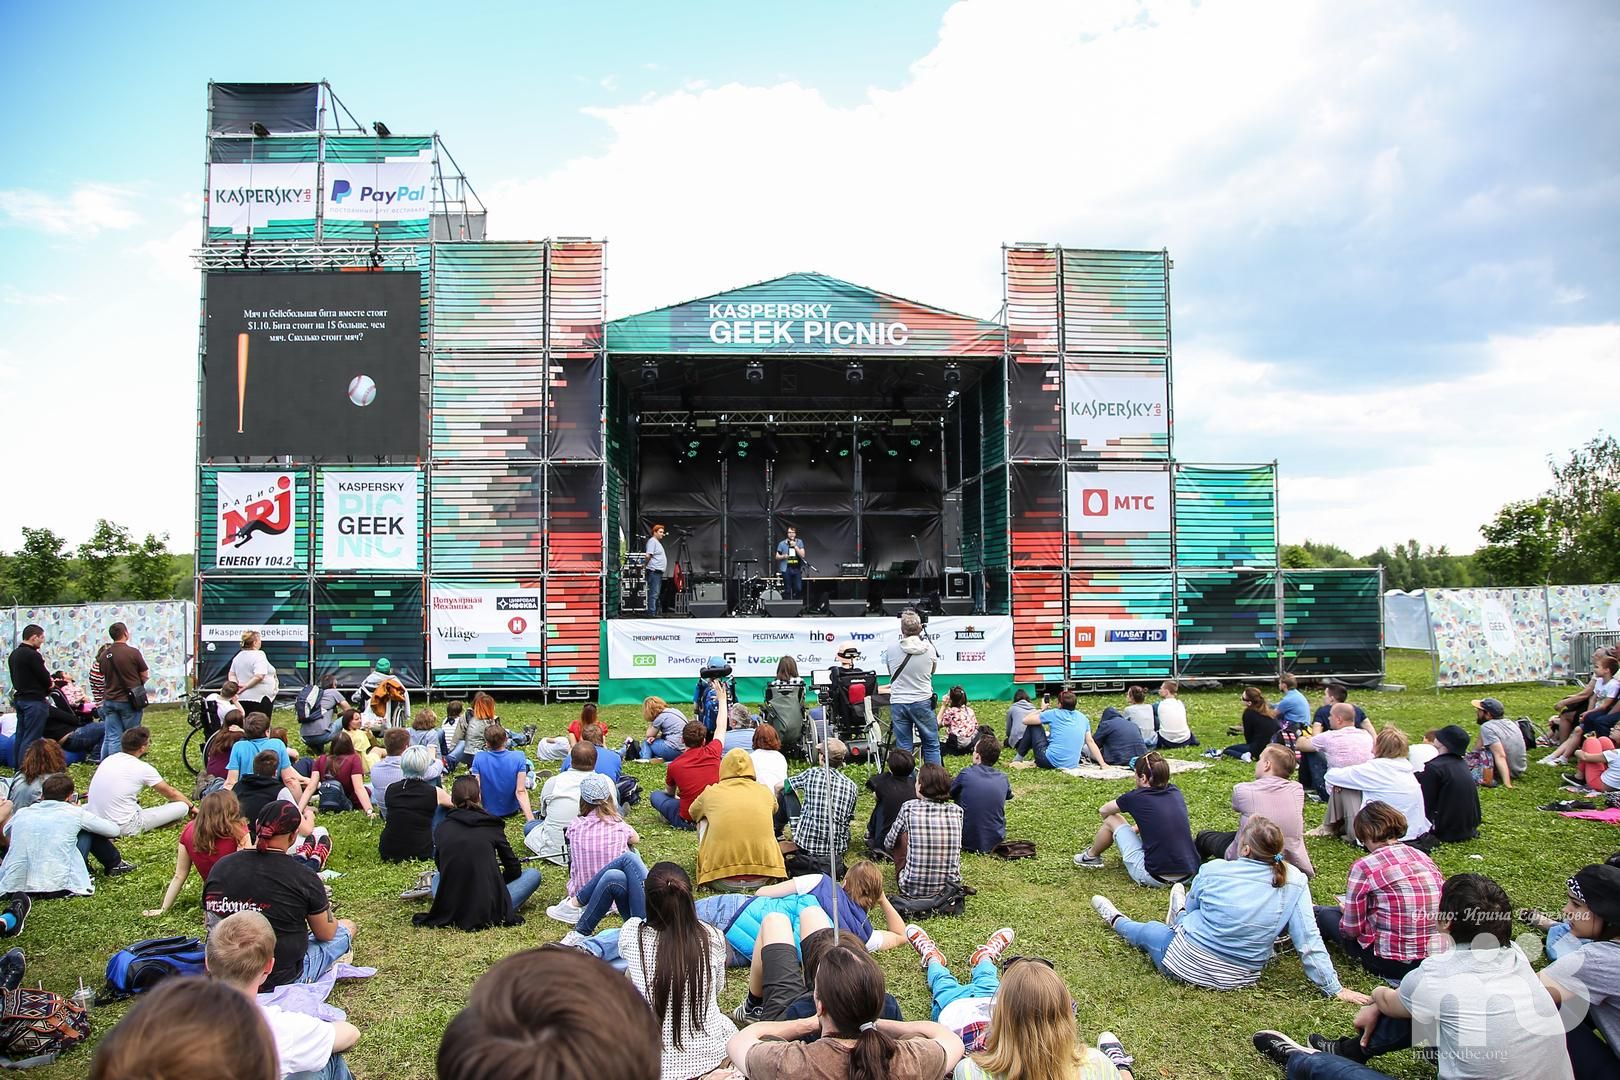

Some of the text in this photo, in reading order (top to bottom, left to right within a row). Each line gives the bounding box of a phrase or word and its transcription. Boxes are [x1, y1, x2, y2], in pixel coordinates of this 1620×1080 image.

[216, 186, 303, 206] KASPERSKY
[303, 188, 311, 203] lab
[360, 186, 425, 205] PayPal
[243, 309, 260, 318] Мяч
[269, 309, 317, 318] бейсбольная
[318, 308, 336, 317] бита
[709, 303, 832, 319] KASPERSKY
[272, 321, 291, 330] Бита
[292, 322, 314, 330] стоит
[709, 320, 909, 346] GEEK PICNIC
[287, 333, 320, 342] Сколько
[344, 332, 364, 341] мяч?
[1071, 399, 1153, 420] KASPERSKY
[1153, 403, 1161, 417] lab
[338, 482, 405, 492] KASPERSKY
[222, 486, 275, 509] РАДИО
[338, 494, 404, 516] PIC
[1114, 495, 1154, 511] МТС
[338, 516, 405, 535] GEEK
[337, 535, 404, 558] NIC
[219, 556, 293, 566] ENERGY 104.2
[437, 626, 480, 642] Village
[850, 631, 875, 642] Утро
[1146, 631, 1163, 641] HD
[634, 655, 655, 665] GEO
